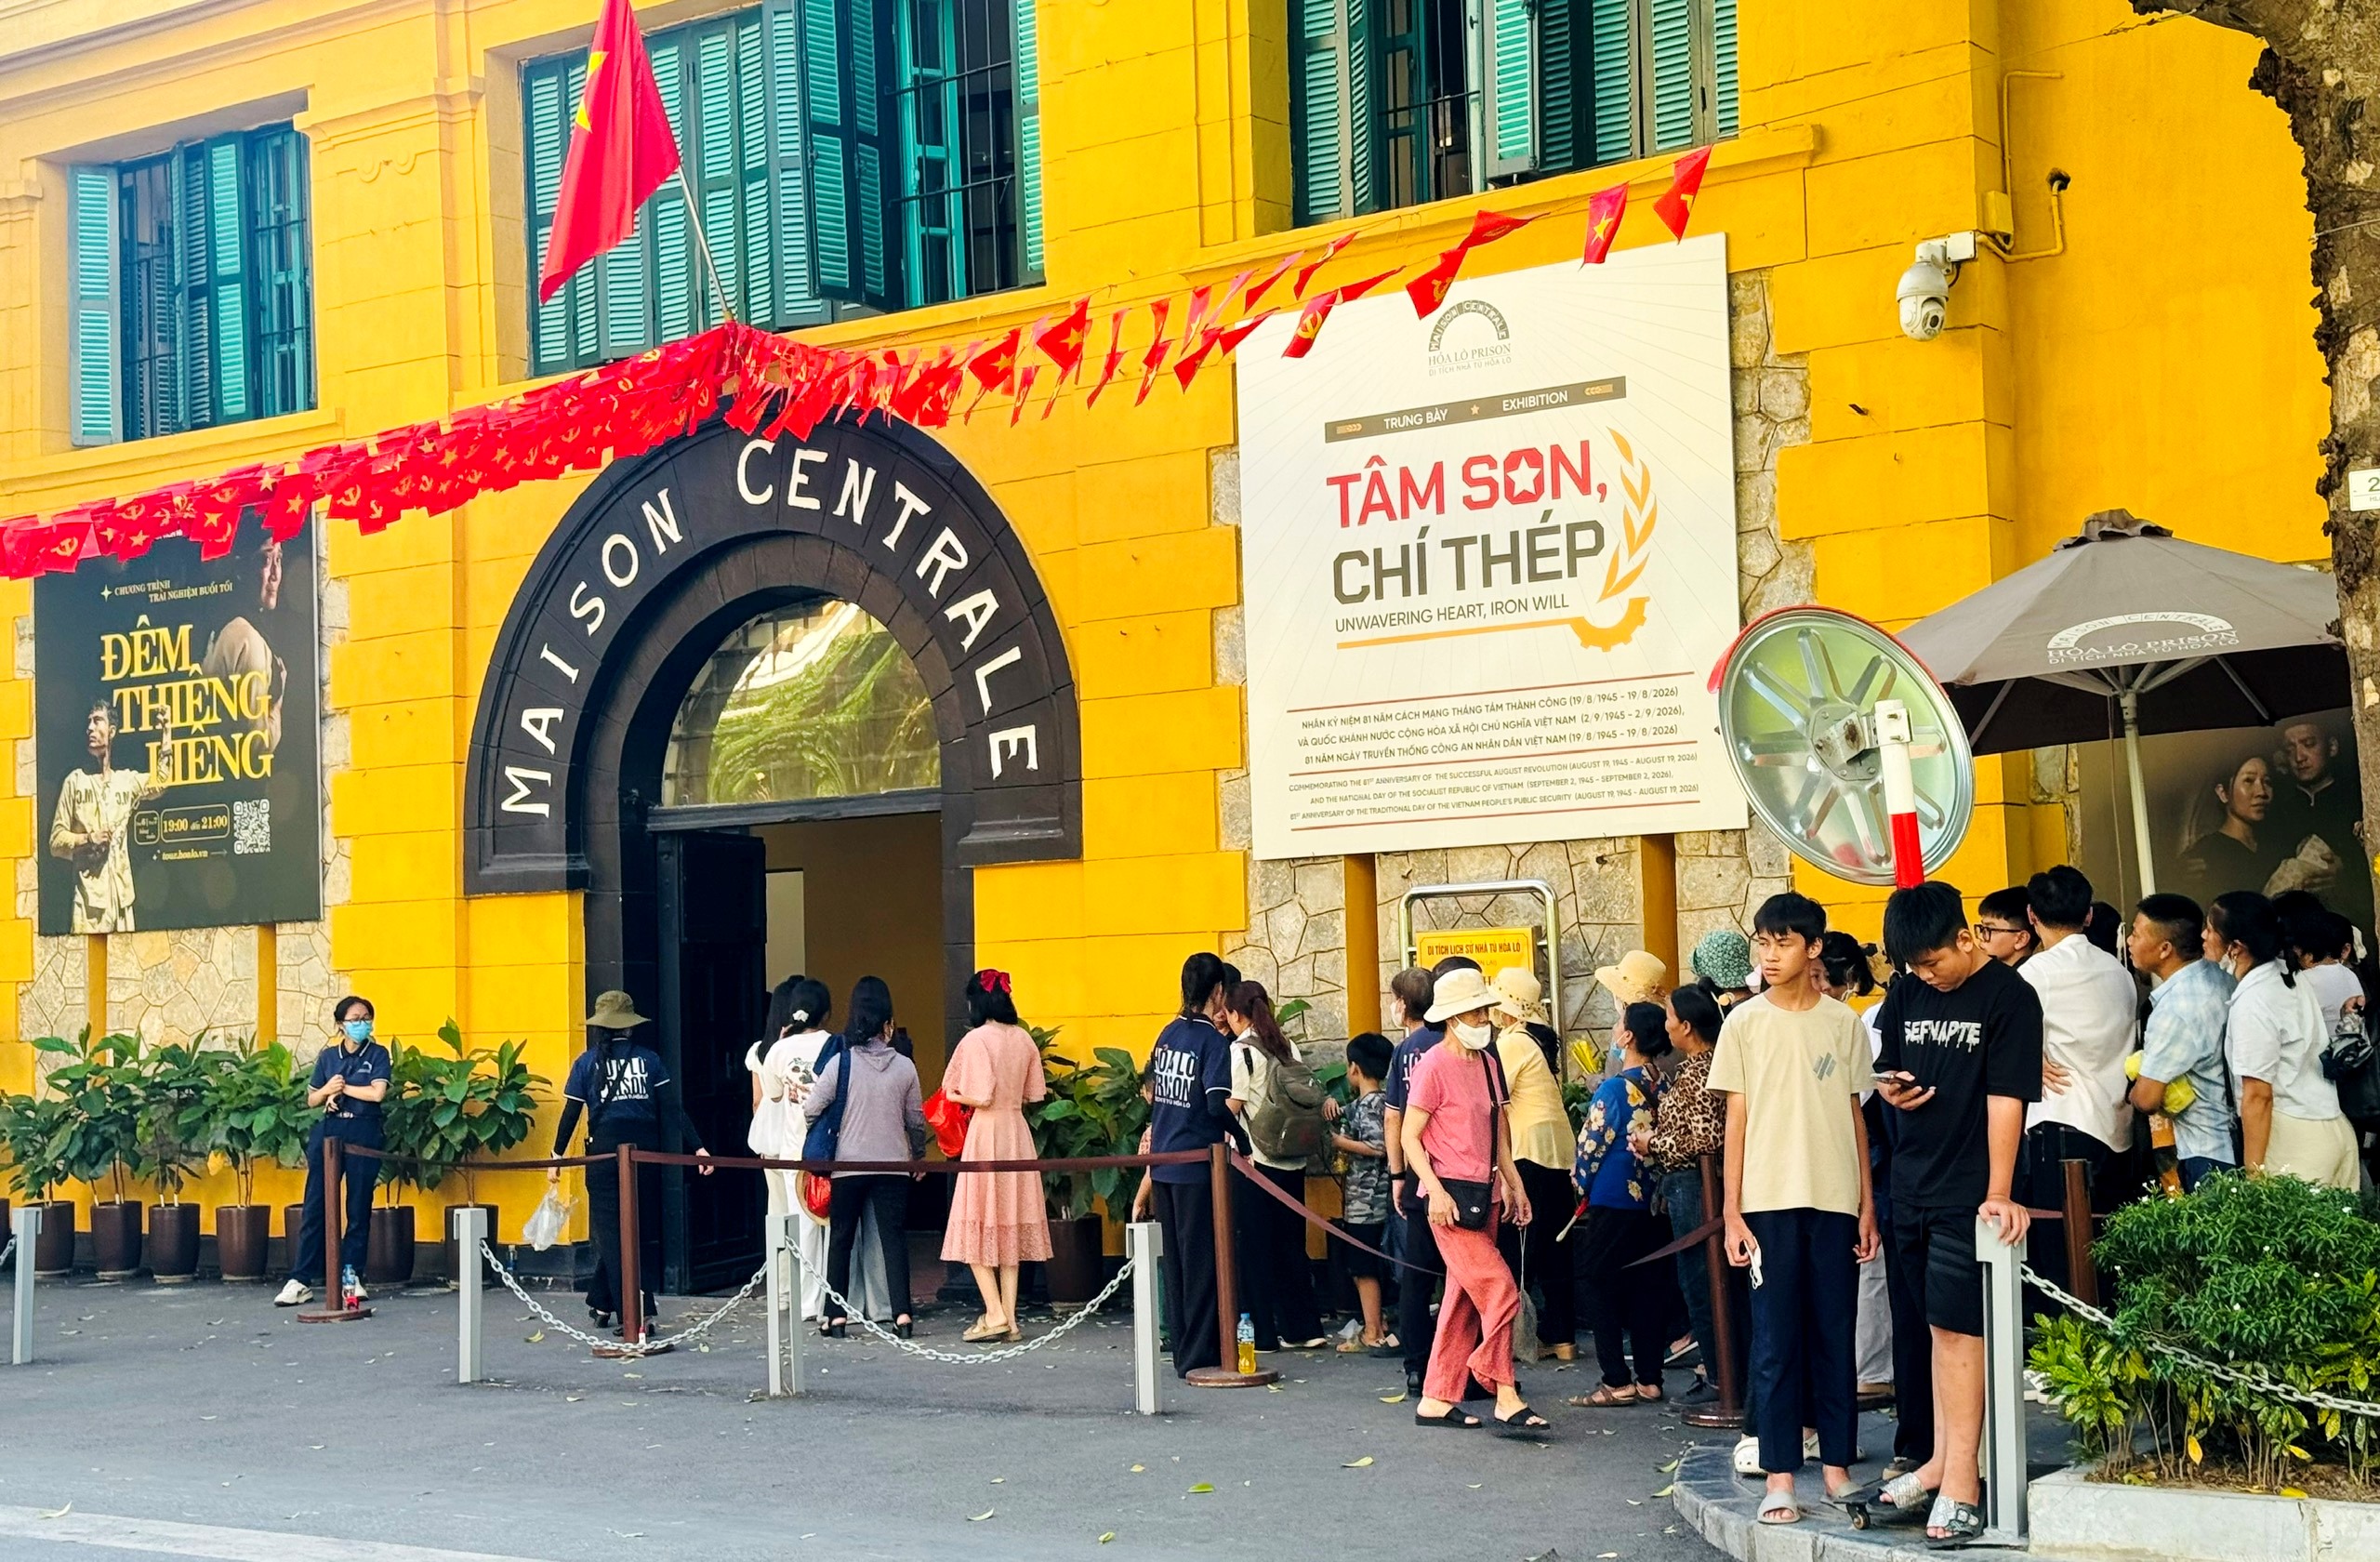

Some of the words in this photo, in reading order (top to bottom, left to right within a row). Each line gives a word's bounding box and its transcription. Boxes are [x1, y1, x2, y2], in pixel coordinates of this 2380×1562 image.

[1472, 343, 1511, 359] PRISON
[1426, 407, 1448, 424] BÀY
[1502, 390, 1568, 412] EXHIBITION
[1326, 455, 1445, 528] TÂM
[1333, 524, 1431, 604] CHÍ
[1441, 509, 1605, 591] THÉP
[501, 487, 682, 818] MAISON
[737, 437, 1041, 780] CENTRALE
[1335, 608, 1433, 633] UNWAVERING
[1437, 602, 1488, 621] HEART,
[1491, 599, 1528, 616] IRON
[1532, 593, 1569, 612] WILL
[100, 614, 193, 681] ĐÊM
[2147, 630, 2237, 649] PRISON
[113, 664, 271, 733] THIÊNG
[1556, 715, 1576, 725] NAM
[1461, 742, 1473, 751] AN
[1546, 735, 1567, 744] NAM
[1449, 770, 1492, 779] SUCCESSFUL
[1494, 767, 1522, 775] AUGUST
[1524, 764, 1567, 774] REVOLUTION
[1635, 756, 1665, 765] AUGUST
[1339, 793, 1371, 802] NATIONAL
[1413, 788, 1447, 797] SOCIALIST
[1448, 786, 1480, 794] REPUBLIC
[1493, 782, 1524, 791] VIETNAM
[1601, 773, 1642, 782] SEPTEMBER
[1451, 800, 1480, 808] VIETNAM
[1514, 796, 1538, 804] PUBLIC
[1540, 794, 1571, 802] SECURITY
[1639, 787, 1668, 795] AUGUST
[164, 818, 188, 833] 19:00
[201, 815, 227, 829] 21:00
